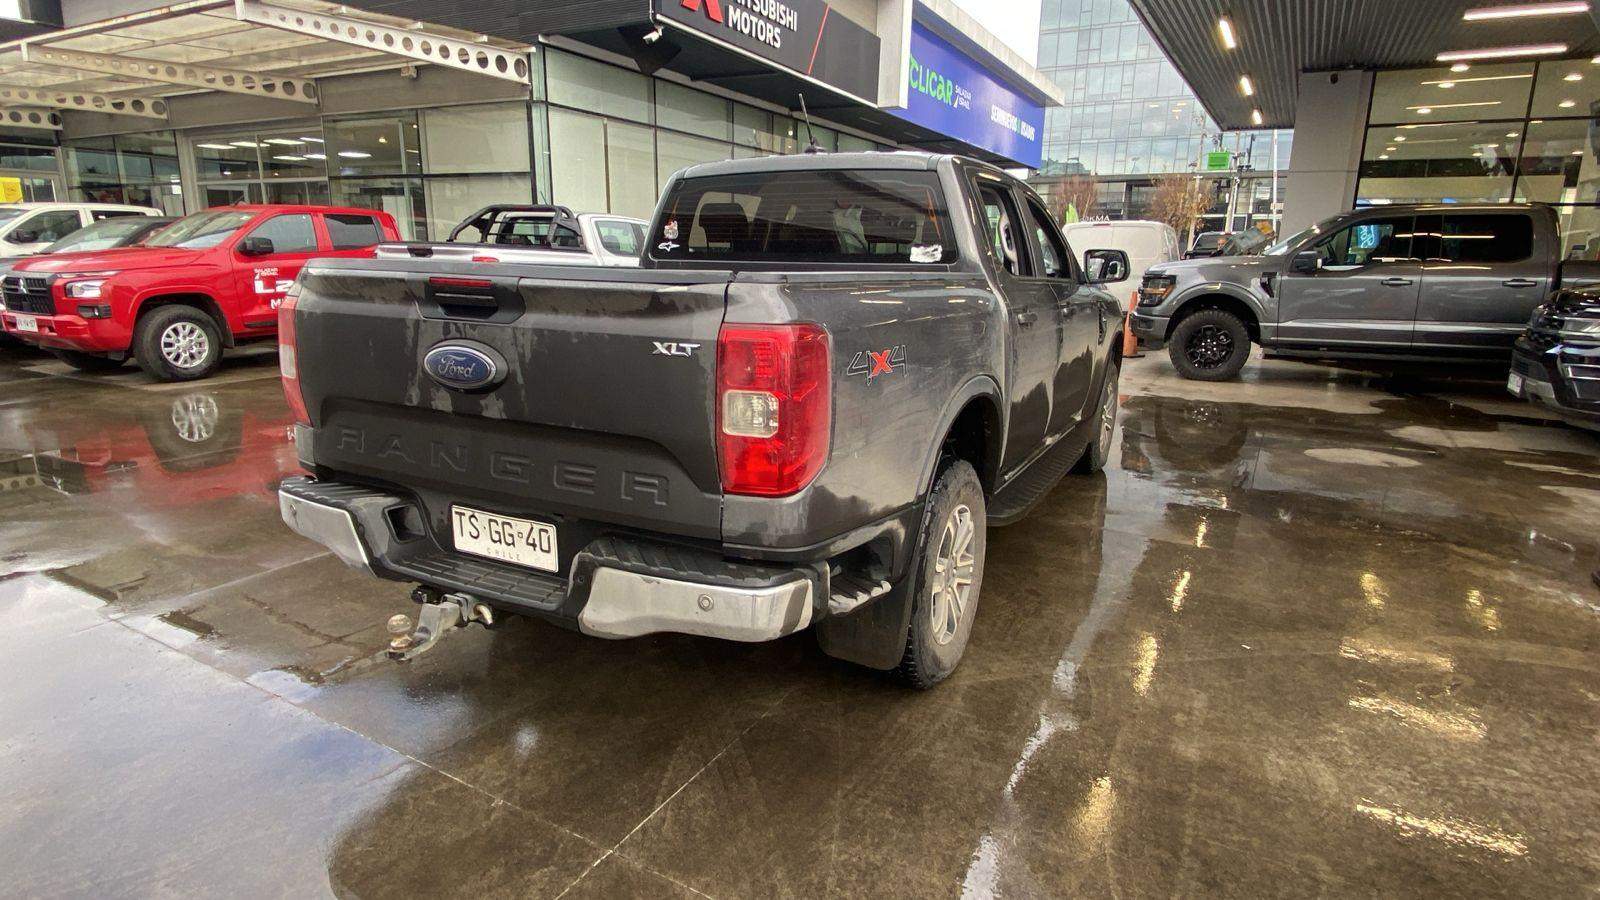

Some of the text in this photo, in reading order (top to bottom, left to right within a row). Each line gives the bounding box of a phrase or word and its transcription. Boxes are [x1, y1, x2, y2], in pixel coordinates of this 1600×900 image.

[728, 5, 781, 49] MOTORS
[737, 0, 798, 32] SUBISHI
[254, 280, 293, 294] L2
[652, 341, 701, 357] XLT
[438, 354, 476, 378] Ford
[336, 425, 669, 506] RANGER
[487, 547, 521, 561] CHILE
